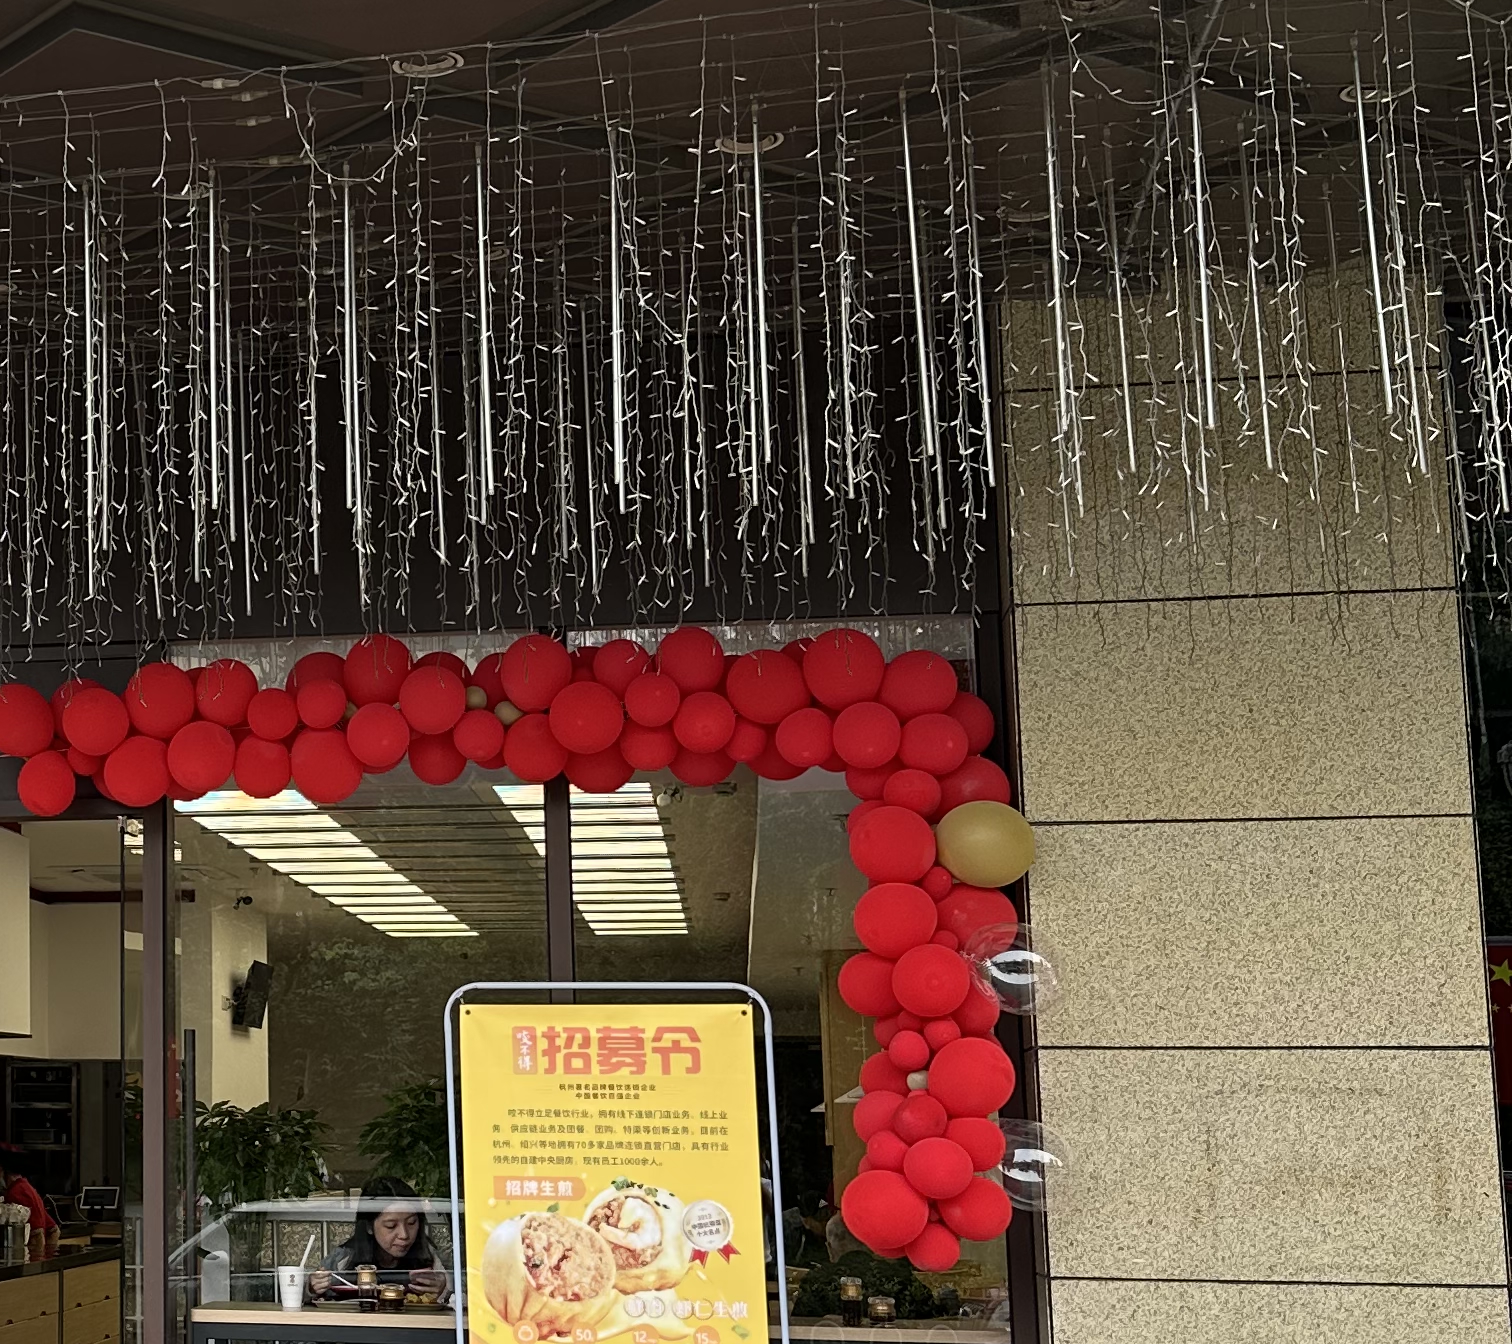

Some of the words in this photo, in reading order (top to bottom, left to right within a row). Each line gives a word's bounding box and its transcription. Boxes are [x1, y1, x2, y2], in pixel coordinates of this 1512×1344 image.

[515, 1030, 533, 1071] 咬不得
[541, 1026, 702, 1075] 招募令
[505, 1179, 574, 1197] 招牌生煎
